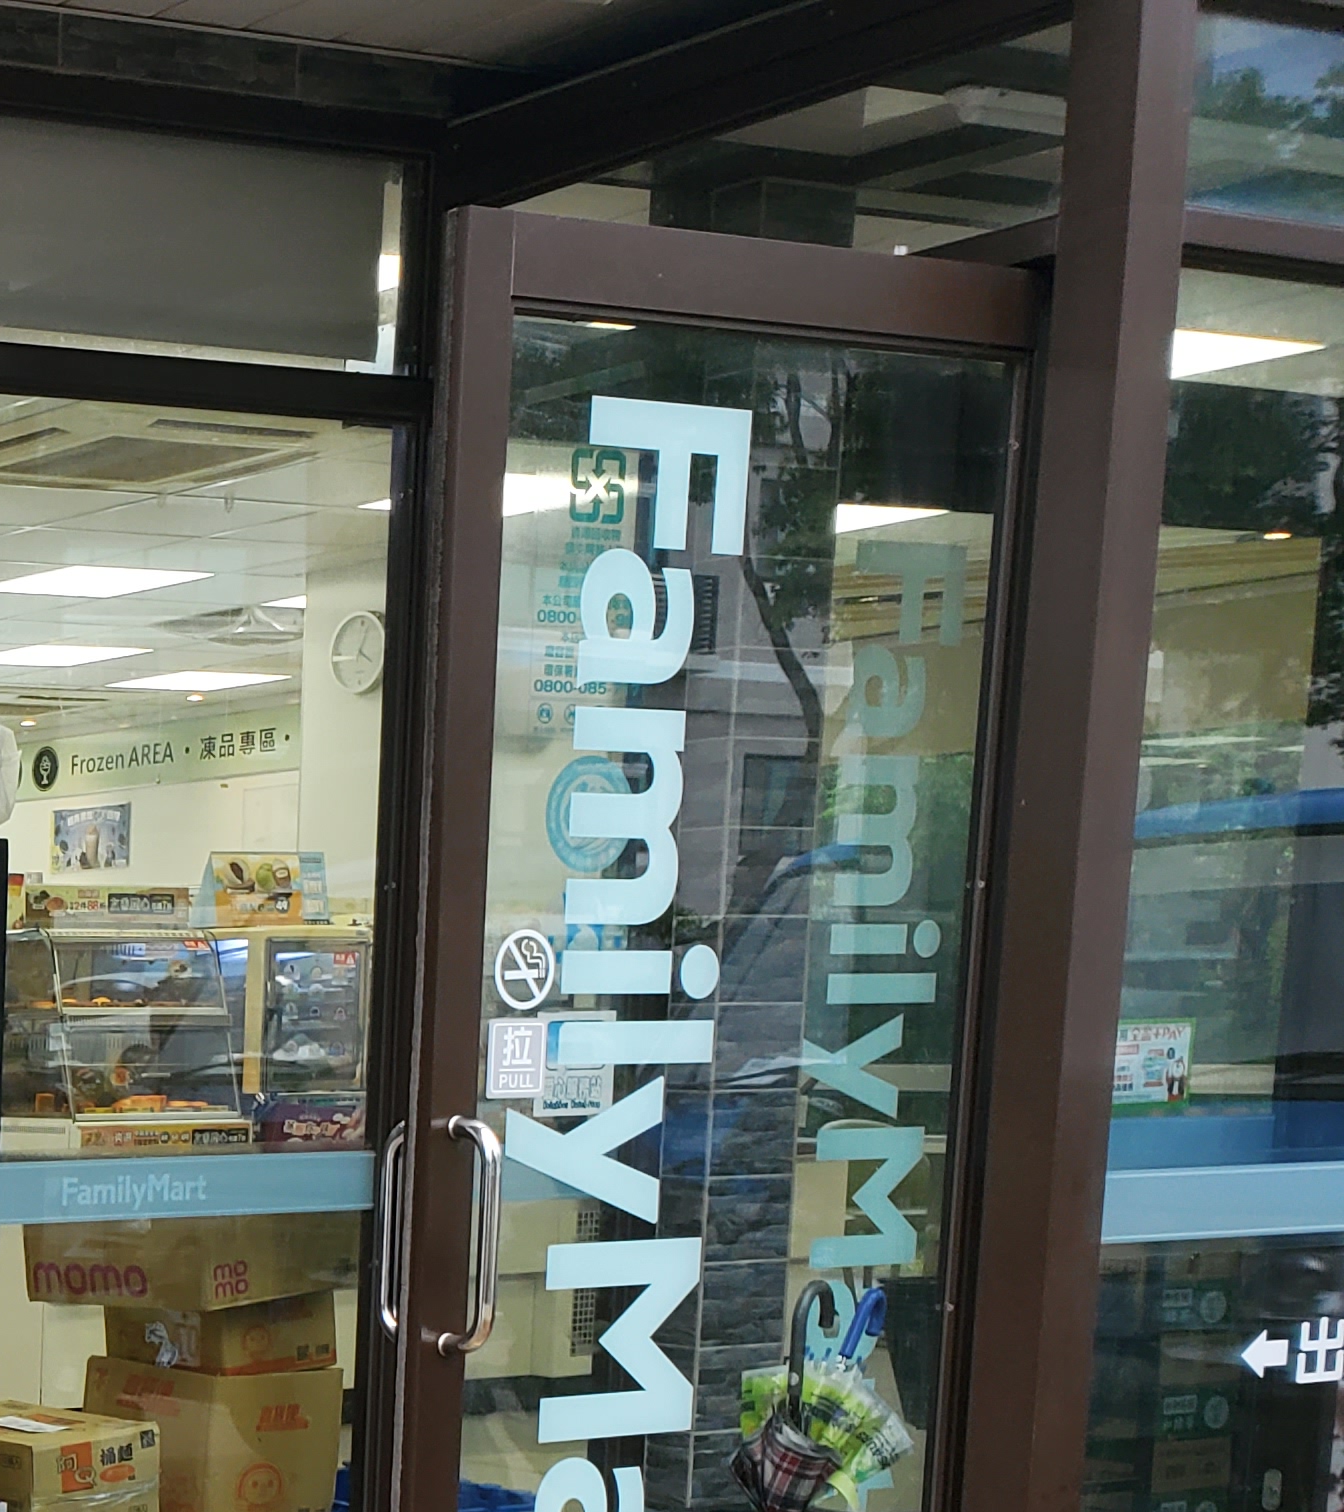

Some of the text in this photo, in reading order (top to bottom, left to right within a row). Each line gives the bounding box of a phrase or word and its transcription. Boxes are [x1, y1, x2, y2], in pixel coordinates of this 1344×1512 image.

[70, 727, 278, 777] Frozen AREA 凍品專區
[502, 1026, 534, 1067] 拉
[498, 1073, 535, 1089] PULL
[62, 1173, 207, 1210] FamilyMart
[33, 1261, 148, 1298] momo
[213, 1259, 248, 1282] mo
[215, 1279, 250, 1300] mo
[1295, 1316, 1344, 1384] 出
